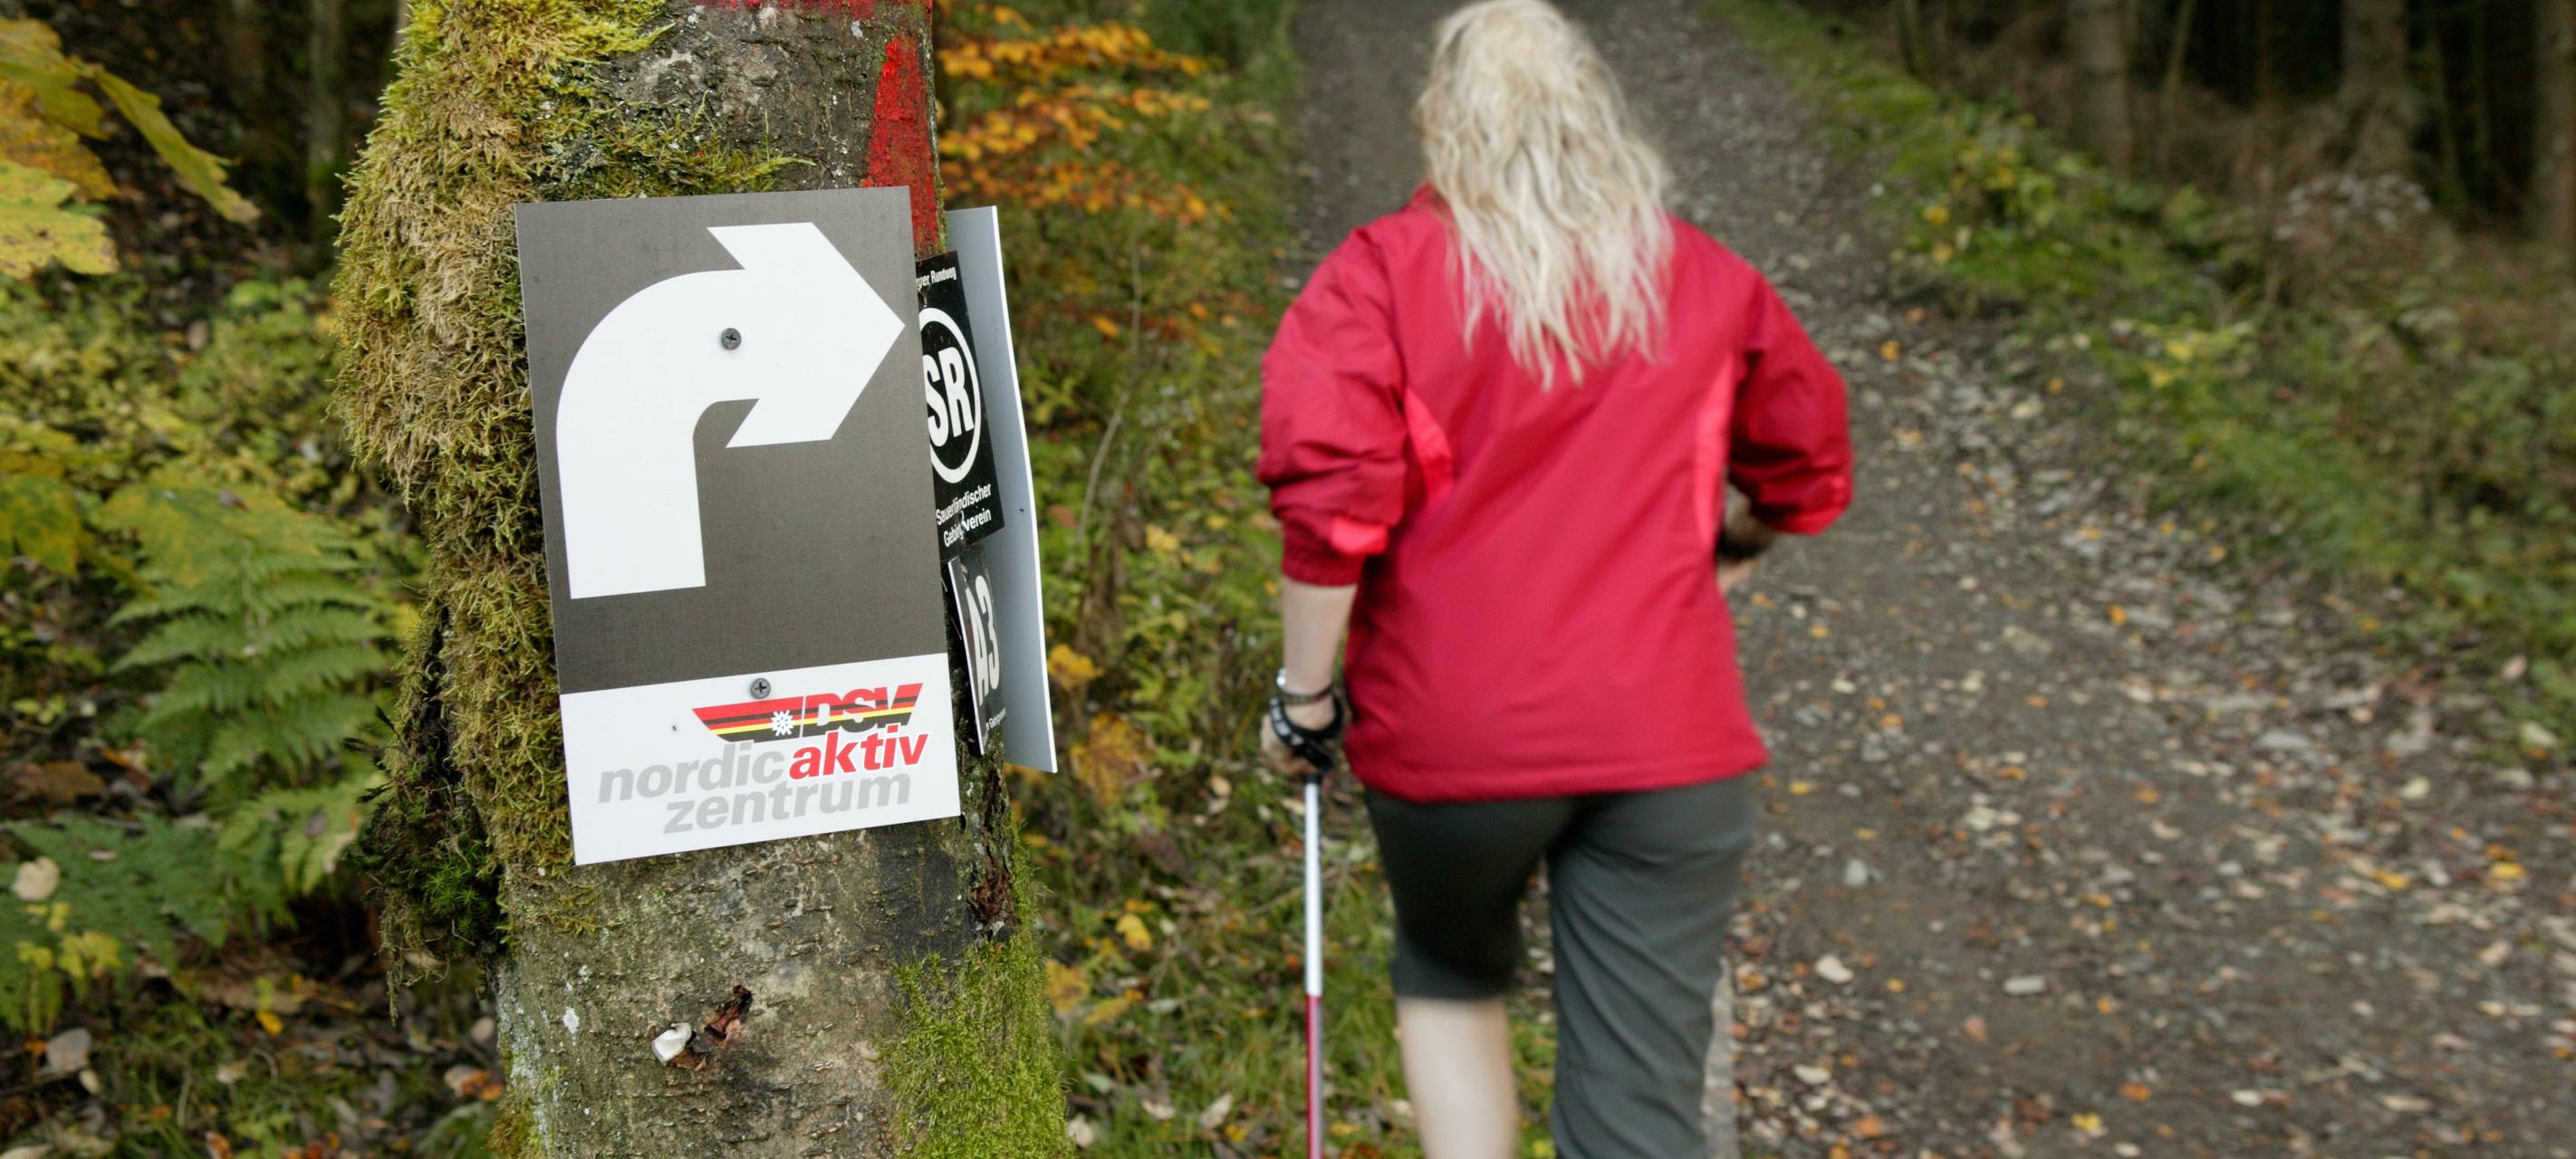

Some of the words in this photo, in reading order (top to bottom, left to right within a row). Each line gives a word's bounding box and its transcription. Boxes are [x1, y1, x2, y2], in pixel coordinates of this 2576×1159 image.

[922, 347, 975, 447] SR
[935, 483, 992, 526] Sauerländischer
[965, 575, 1000, 706] A3
[801, 683, 924, 738] DSV
[598, 741, 785, 803] nordic
[788, 723, 929, 781] aktiv
[663, 773, 912, 835] zentrum
